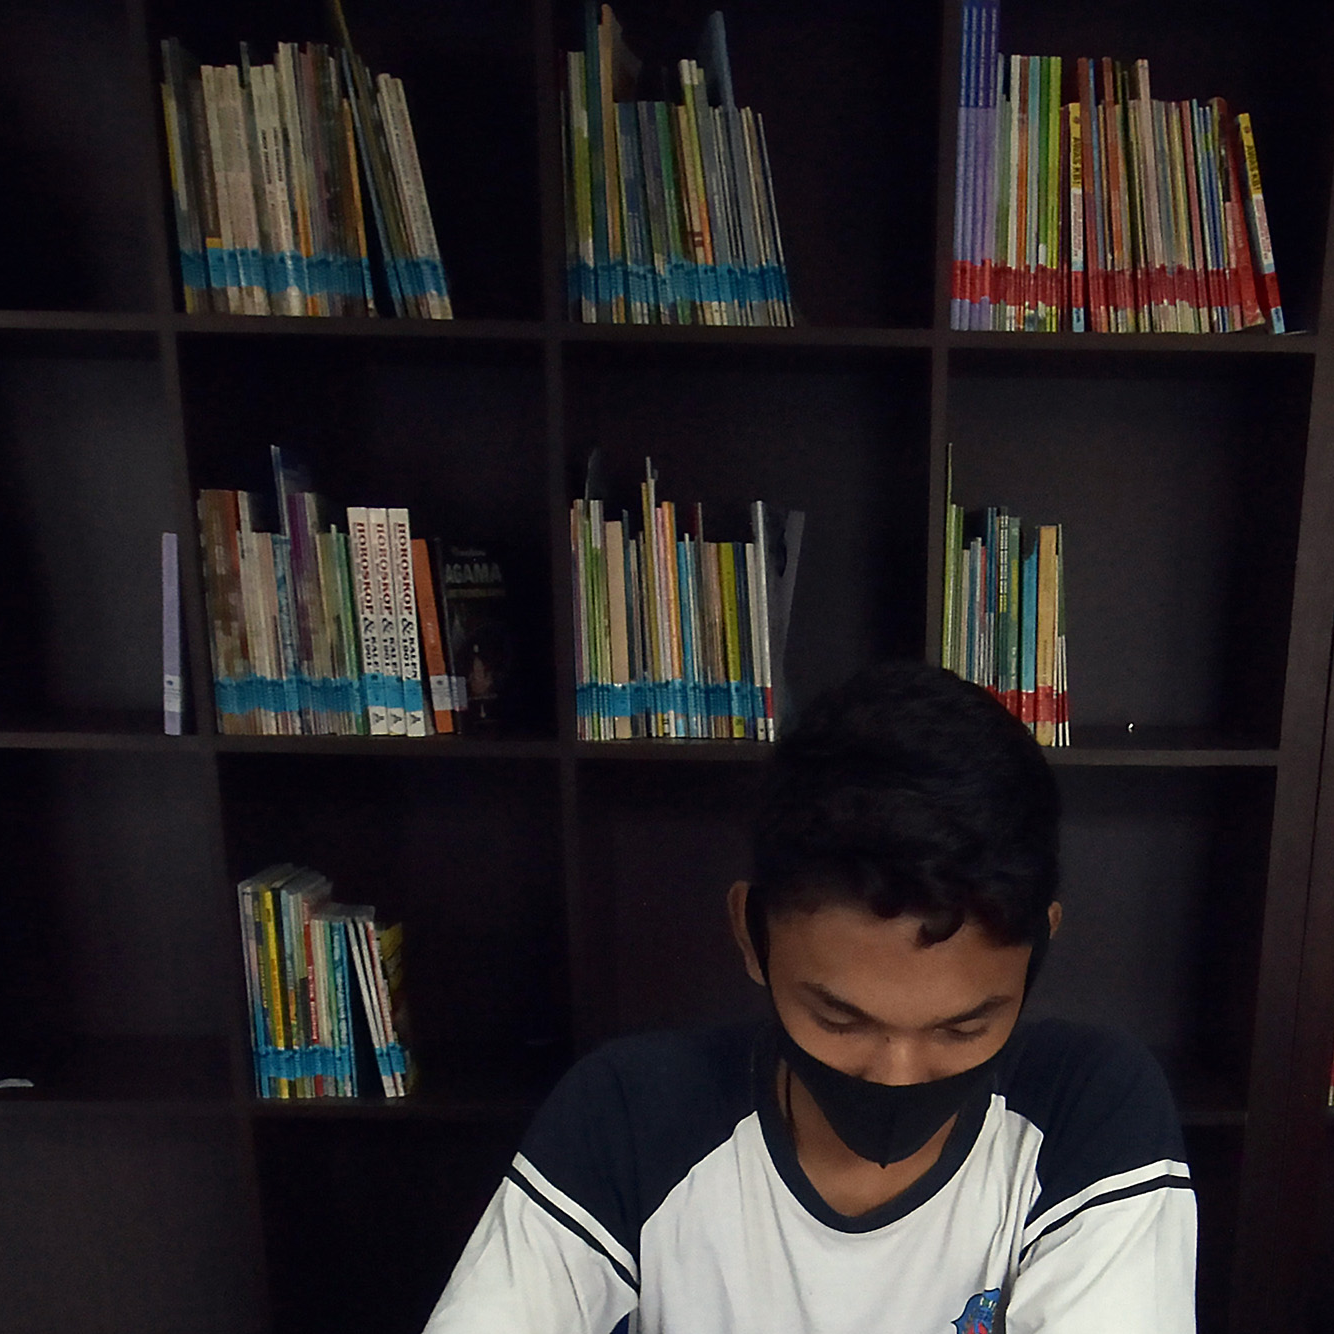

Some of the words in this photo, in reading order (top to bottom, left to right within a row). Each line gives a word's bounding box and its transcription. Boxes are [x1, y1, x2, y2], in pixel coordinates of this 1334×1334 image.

[356, 522, 373, 614] HOROSKOP
[377, 522, 393, 614] HOROSKOP
[397, 521, 412, 615] HOROSKOP
[402, 617, 414, 636] &
